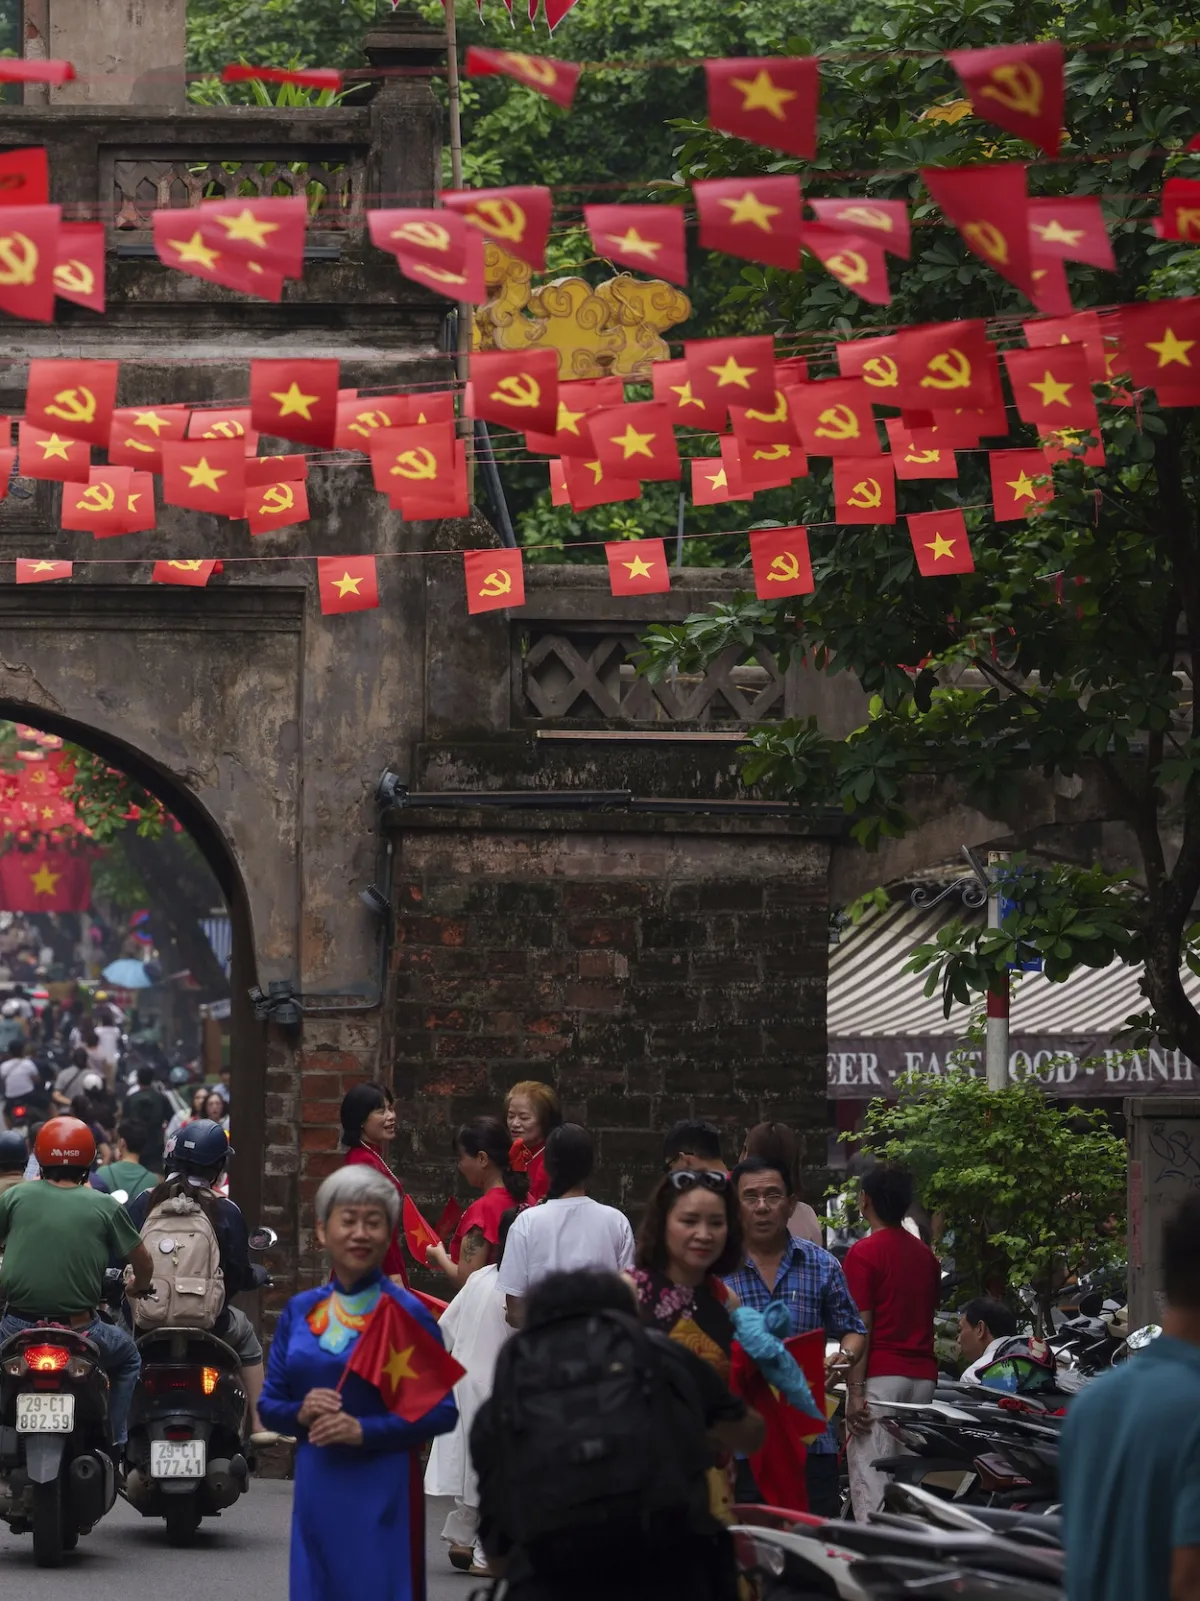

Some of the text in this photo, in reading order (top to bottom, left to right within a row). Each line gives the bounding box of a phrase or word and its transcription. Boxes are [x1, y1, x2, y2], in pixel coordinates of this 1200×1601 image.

[1008, 1049, 1078, 1084] OOD
[63, 1149, 80, 1157] MSB
[25, 1396, 65, 1412] 29-C1
[20, 1414, 69, 1429] 882.59
[158, 1443, 197, 1458] 29-C1
[156, 1460, 202, 1475] 177.41
